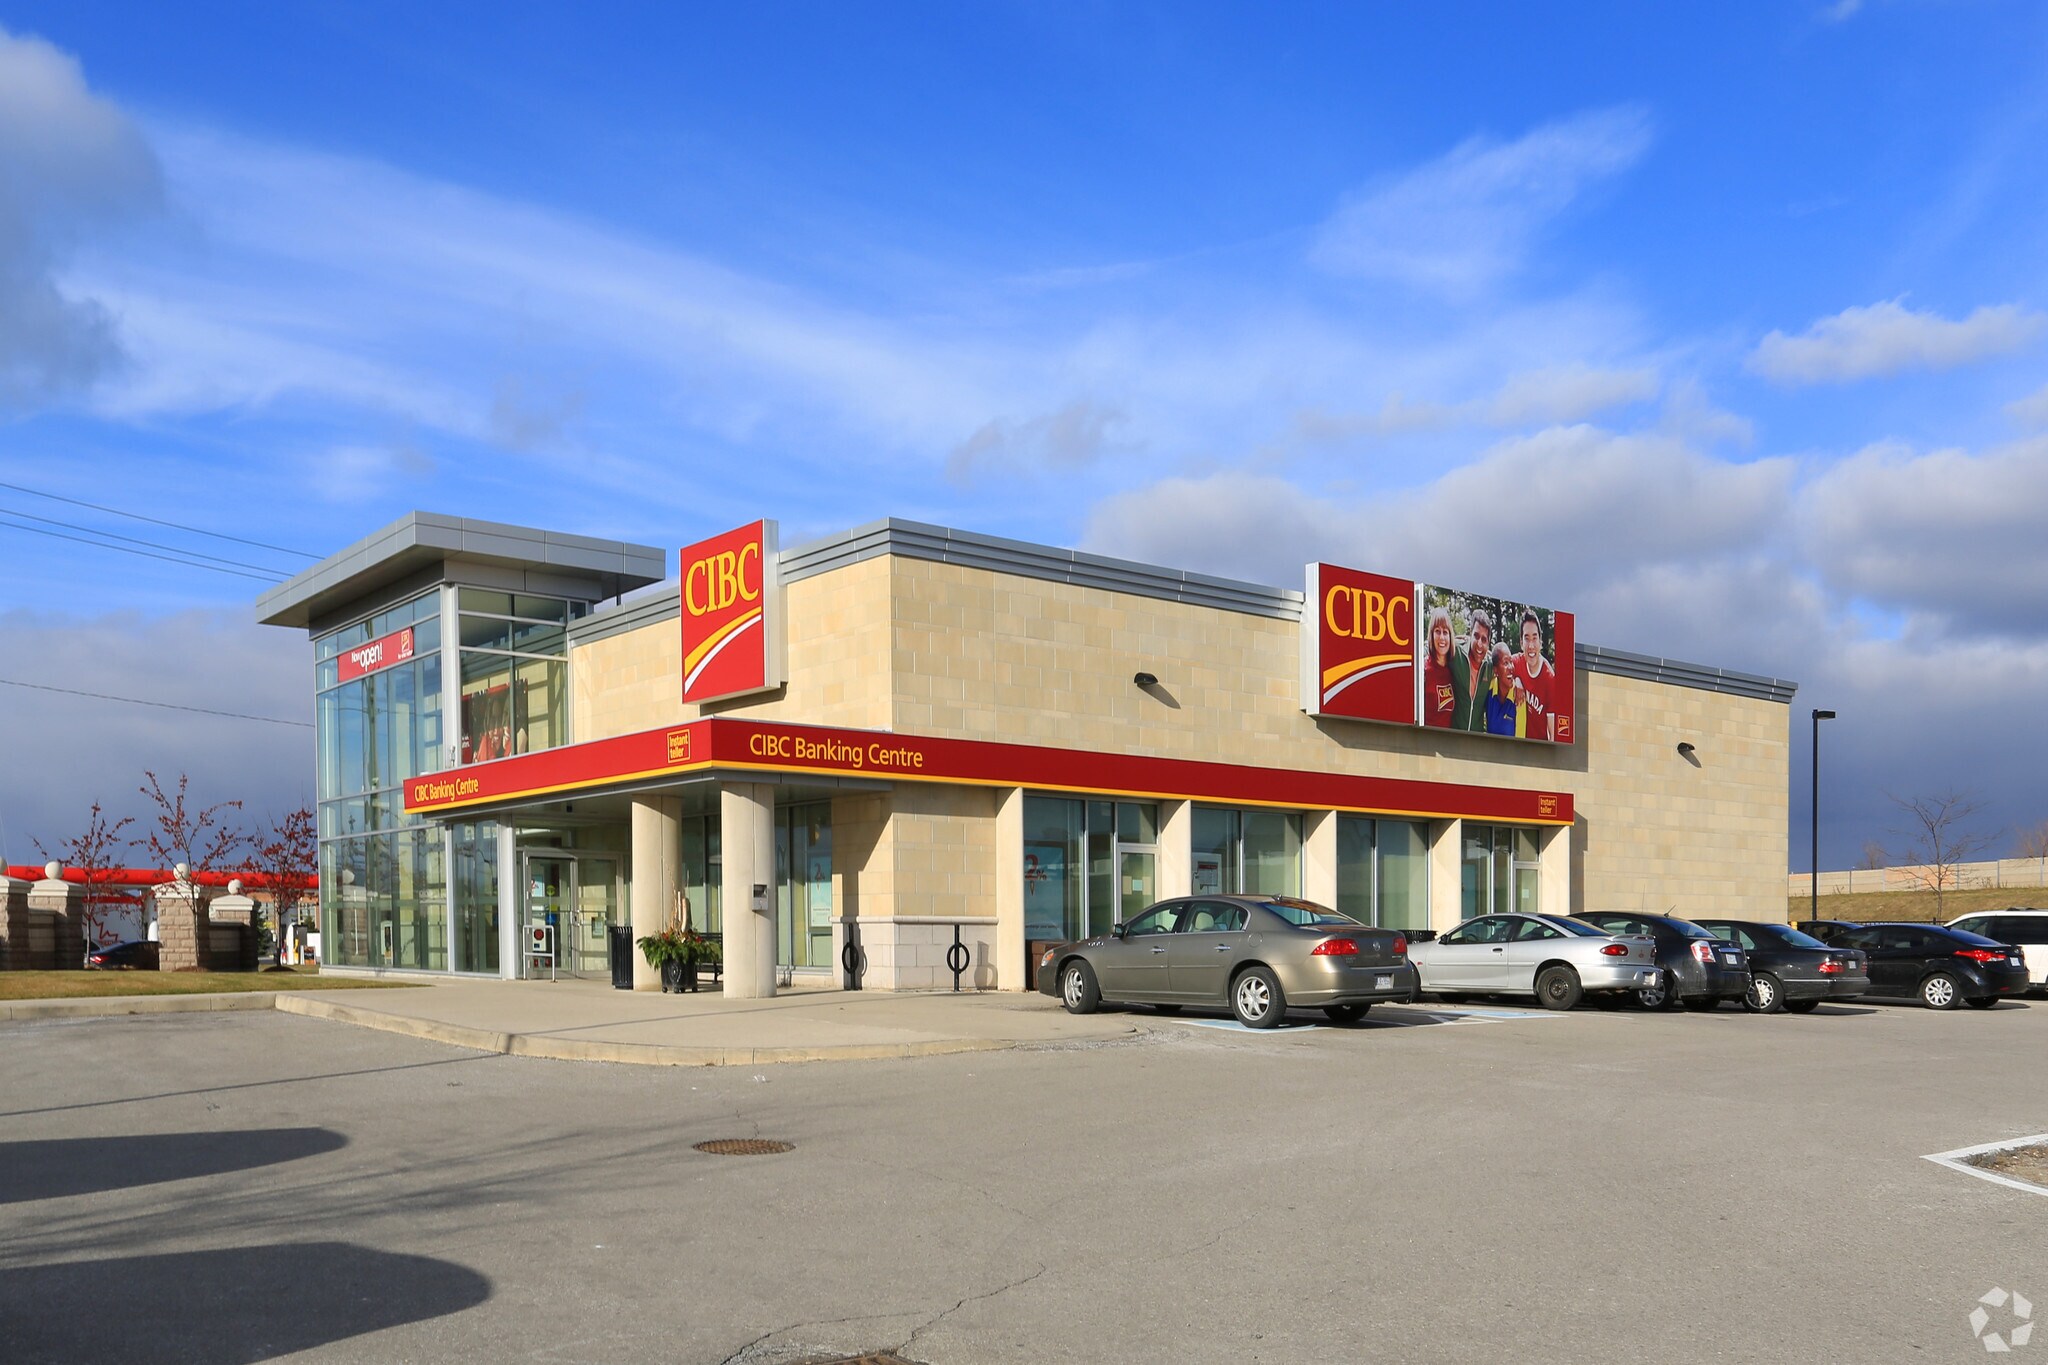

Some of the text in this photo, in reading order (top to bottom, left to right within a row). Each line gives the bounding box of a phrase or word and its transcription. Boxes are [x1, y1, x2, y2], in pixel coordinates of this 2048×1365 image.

[685, 542, 759, 616] CIBC
[1325, 584, 1409, 646] CIBC
[360, 641, 383, 672] open!
[1439, 687, 1453, 697] CIBC
[1525, 690, 1544, 715] NADA
[669, 733, 689, 748] Instant
[669, 746, 685, 759] teller
[749, 733, 923, 769] CIBC Banking Centre
[414, 777, 479, 802] CIBC Banking Centre
[1540, 798, 1556, 807] Instant
[1540, 805, 1553, 814] teller
